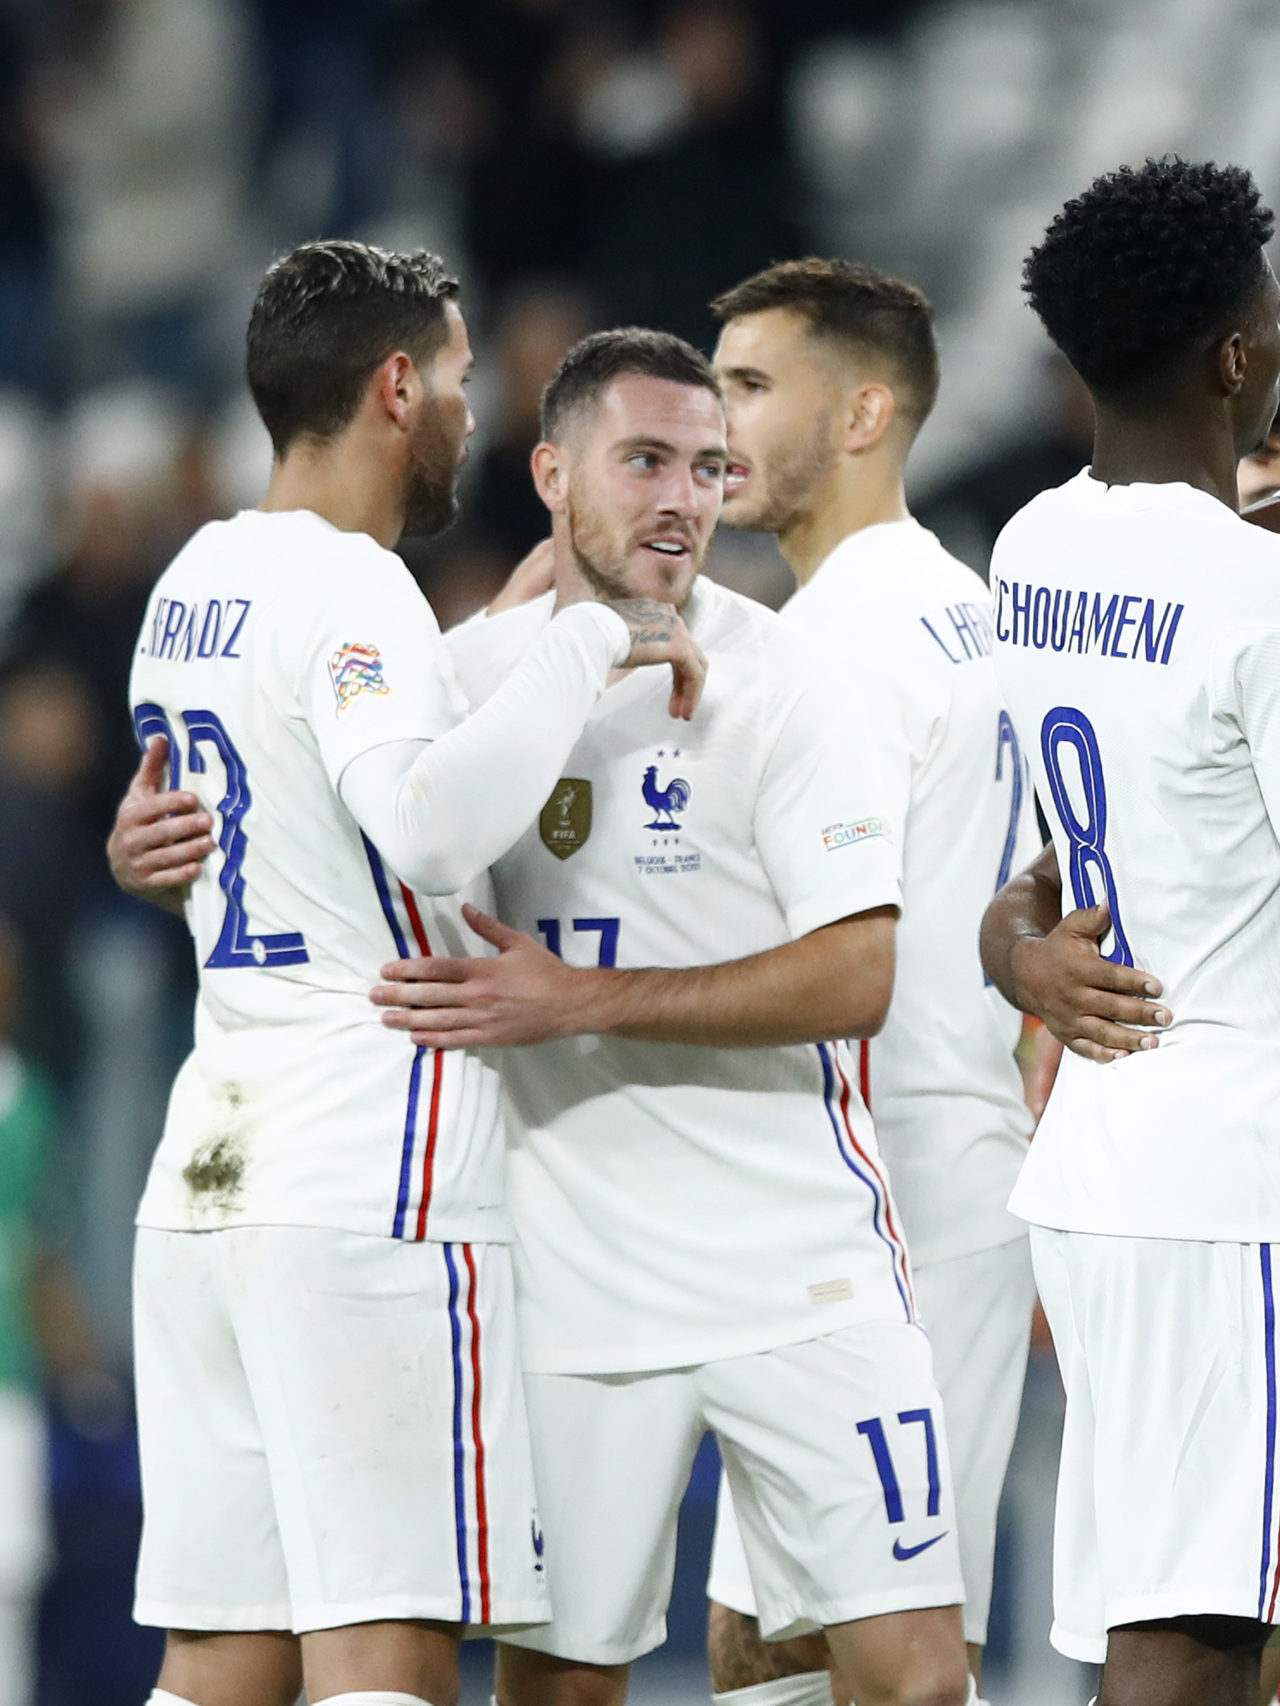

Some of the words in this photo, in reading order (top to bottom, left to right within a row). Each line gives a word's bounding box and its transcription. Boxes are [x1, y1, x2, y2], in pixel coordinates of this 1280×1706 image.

[994, 575, 1184, 664] CHOUAMENI
[1040, 706, 1134, 966] 8
[856, 1408, 940, 1524] 17
